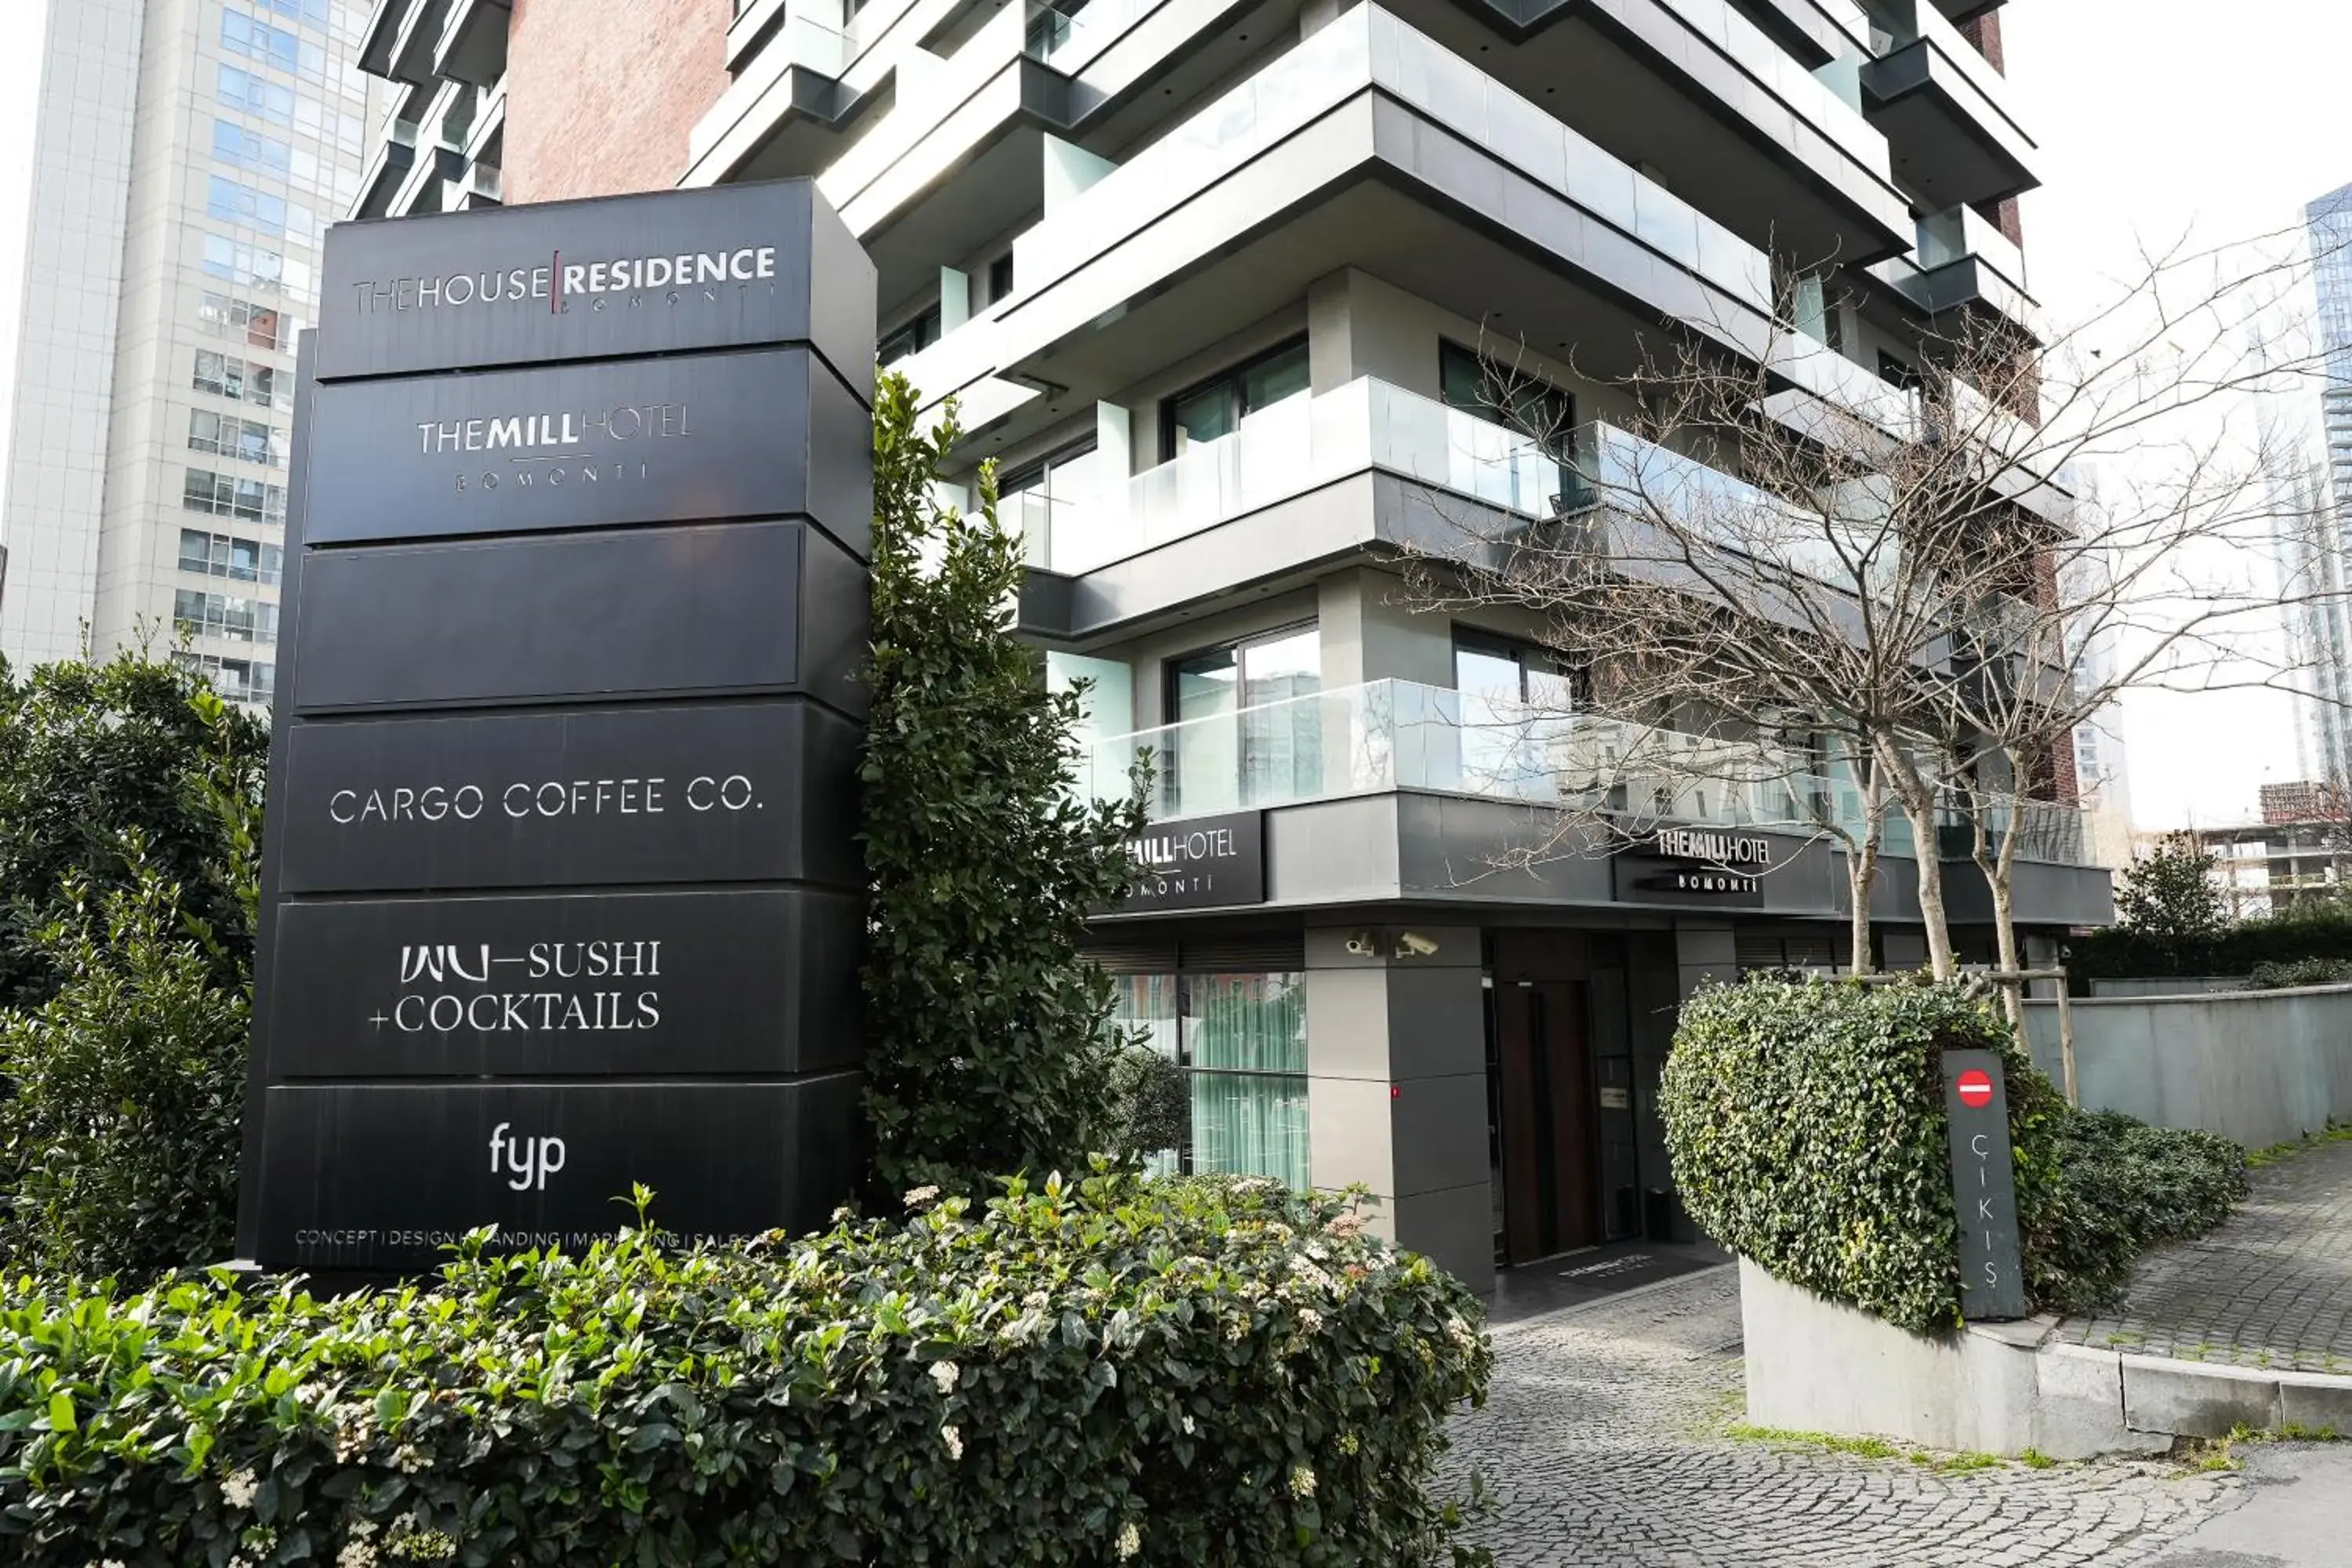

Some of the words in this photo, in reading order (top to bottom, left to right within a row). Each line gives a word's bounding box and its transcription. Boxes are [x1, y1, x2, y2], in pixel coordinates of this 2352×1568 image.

[563, 246, 775, 295] RESIDENCE
[455, 463, 648, 492] BOMONTI
[330, 785, 484, 823] CARGO
[503, 779, 666, 818] COFFEE
[687, 775, 764, 811] CO.
[488, 1122, 564, 1190] fyp
[295, 1229, 377, 1247] CONCEPT
[389, 1229, 455, 1247] DESIGN
[467, 1229, 561, 1248] ANDING
